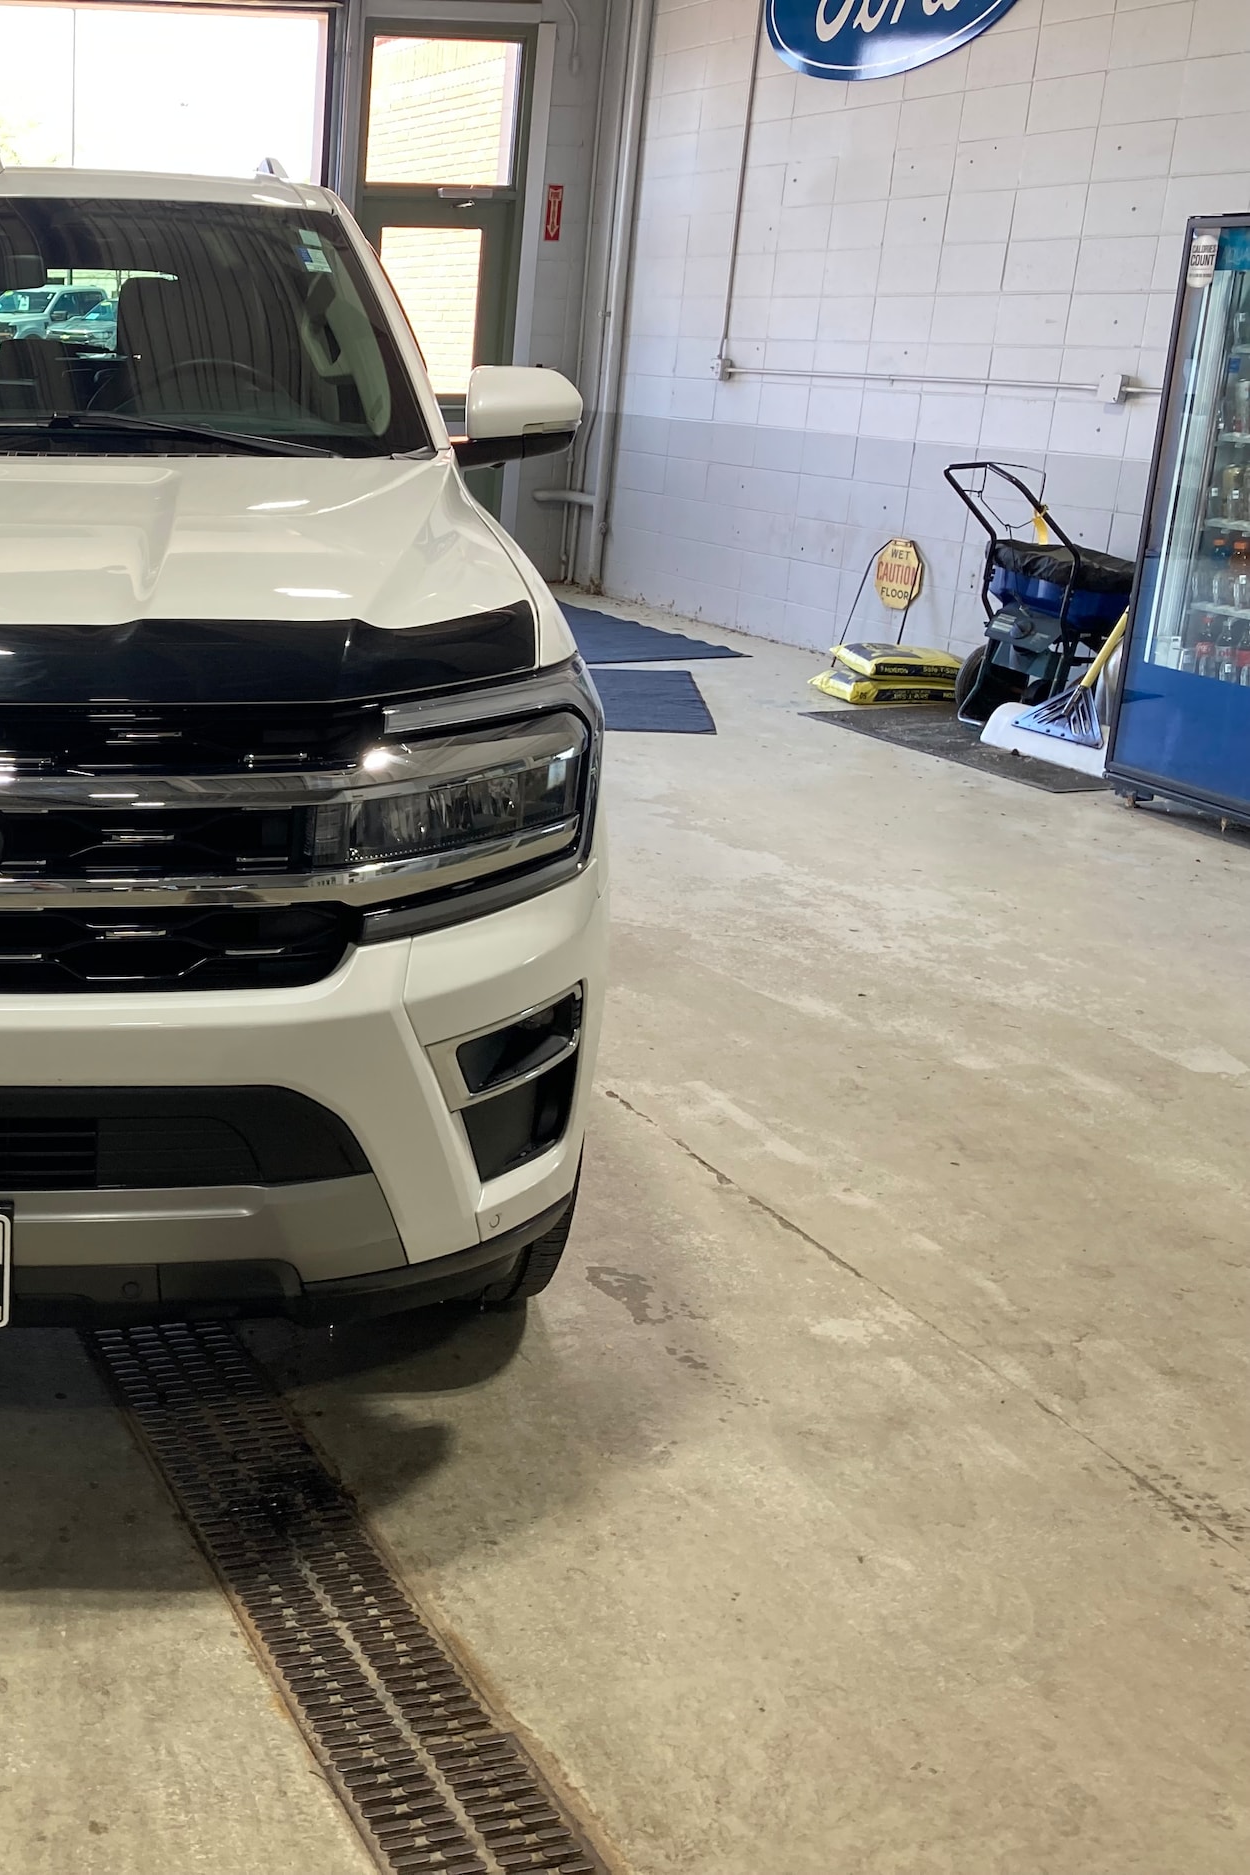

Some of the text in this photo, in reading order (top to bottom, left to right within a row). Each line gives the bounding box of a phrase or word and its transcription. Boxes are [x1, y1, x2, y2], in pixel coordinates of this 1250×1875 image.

[1192, 245, 1217, 253] CALORIES
[1190, 254, 1215, 266] COUNT
[891, 549, 911, 560] WET
[880, 587, 909, 600] FLOOR
